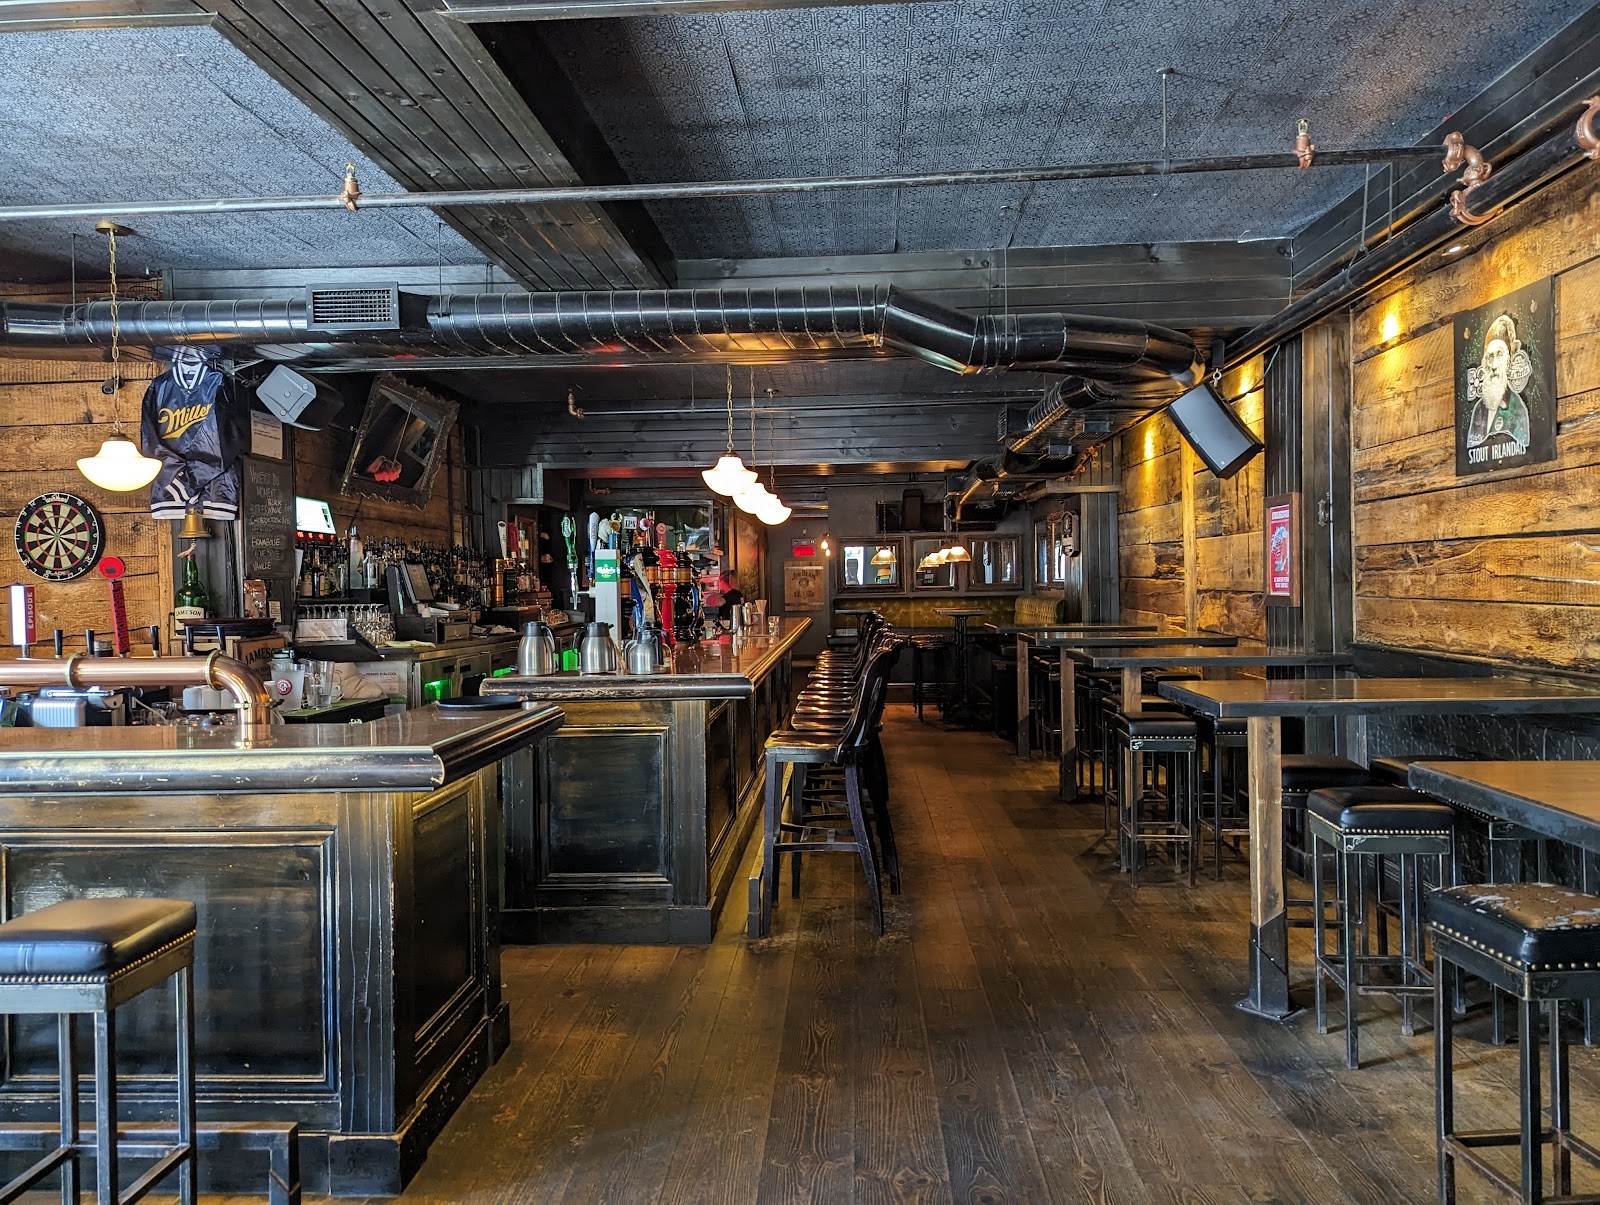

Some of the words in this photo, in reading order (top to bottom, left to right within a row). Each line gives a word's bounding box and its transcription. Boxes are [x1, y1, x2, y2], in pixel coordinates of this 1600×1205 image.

[158, 404, 213, 434] Miller
[1468, 446, 1489, 464] STOUT
[1491, 441, 1527, 460] IRLANDAIS
[245, 647, 273, 666] JAMES
